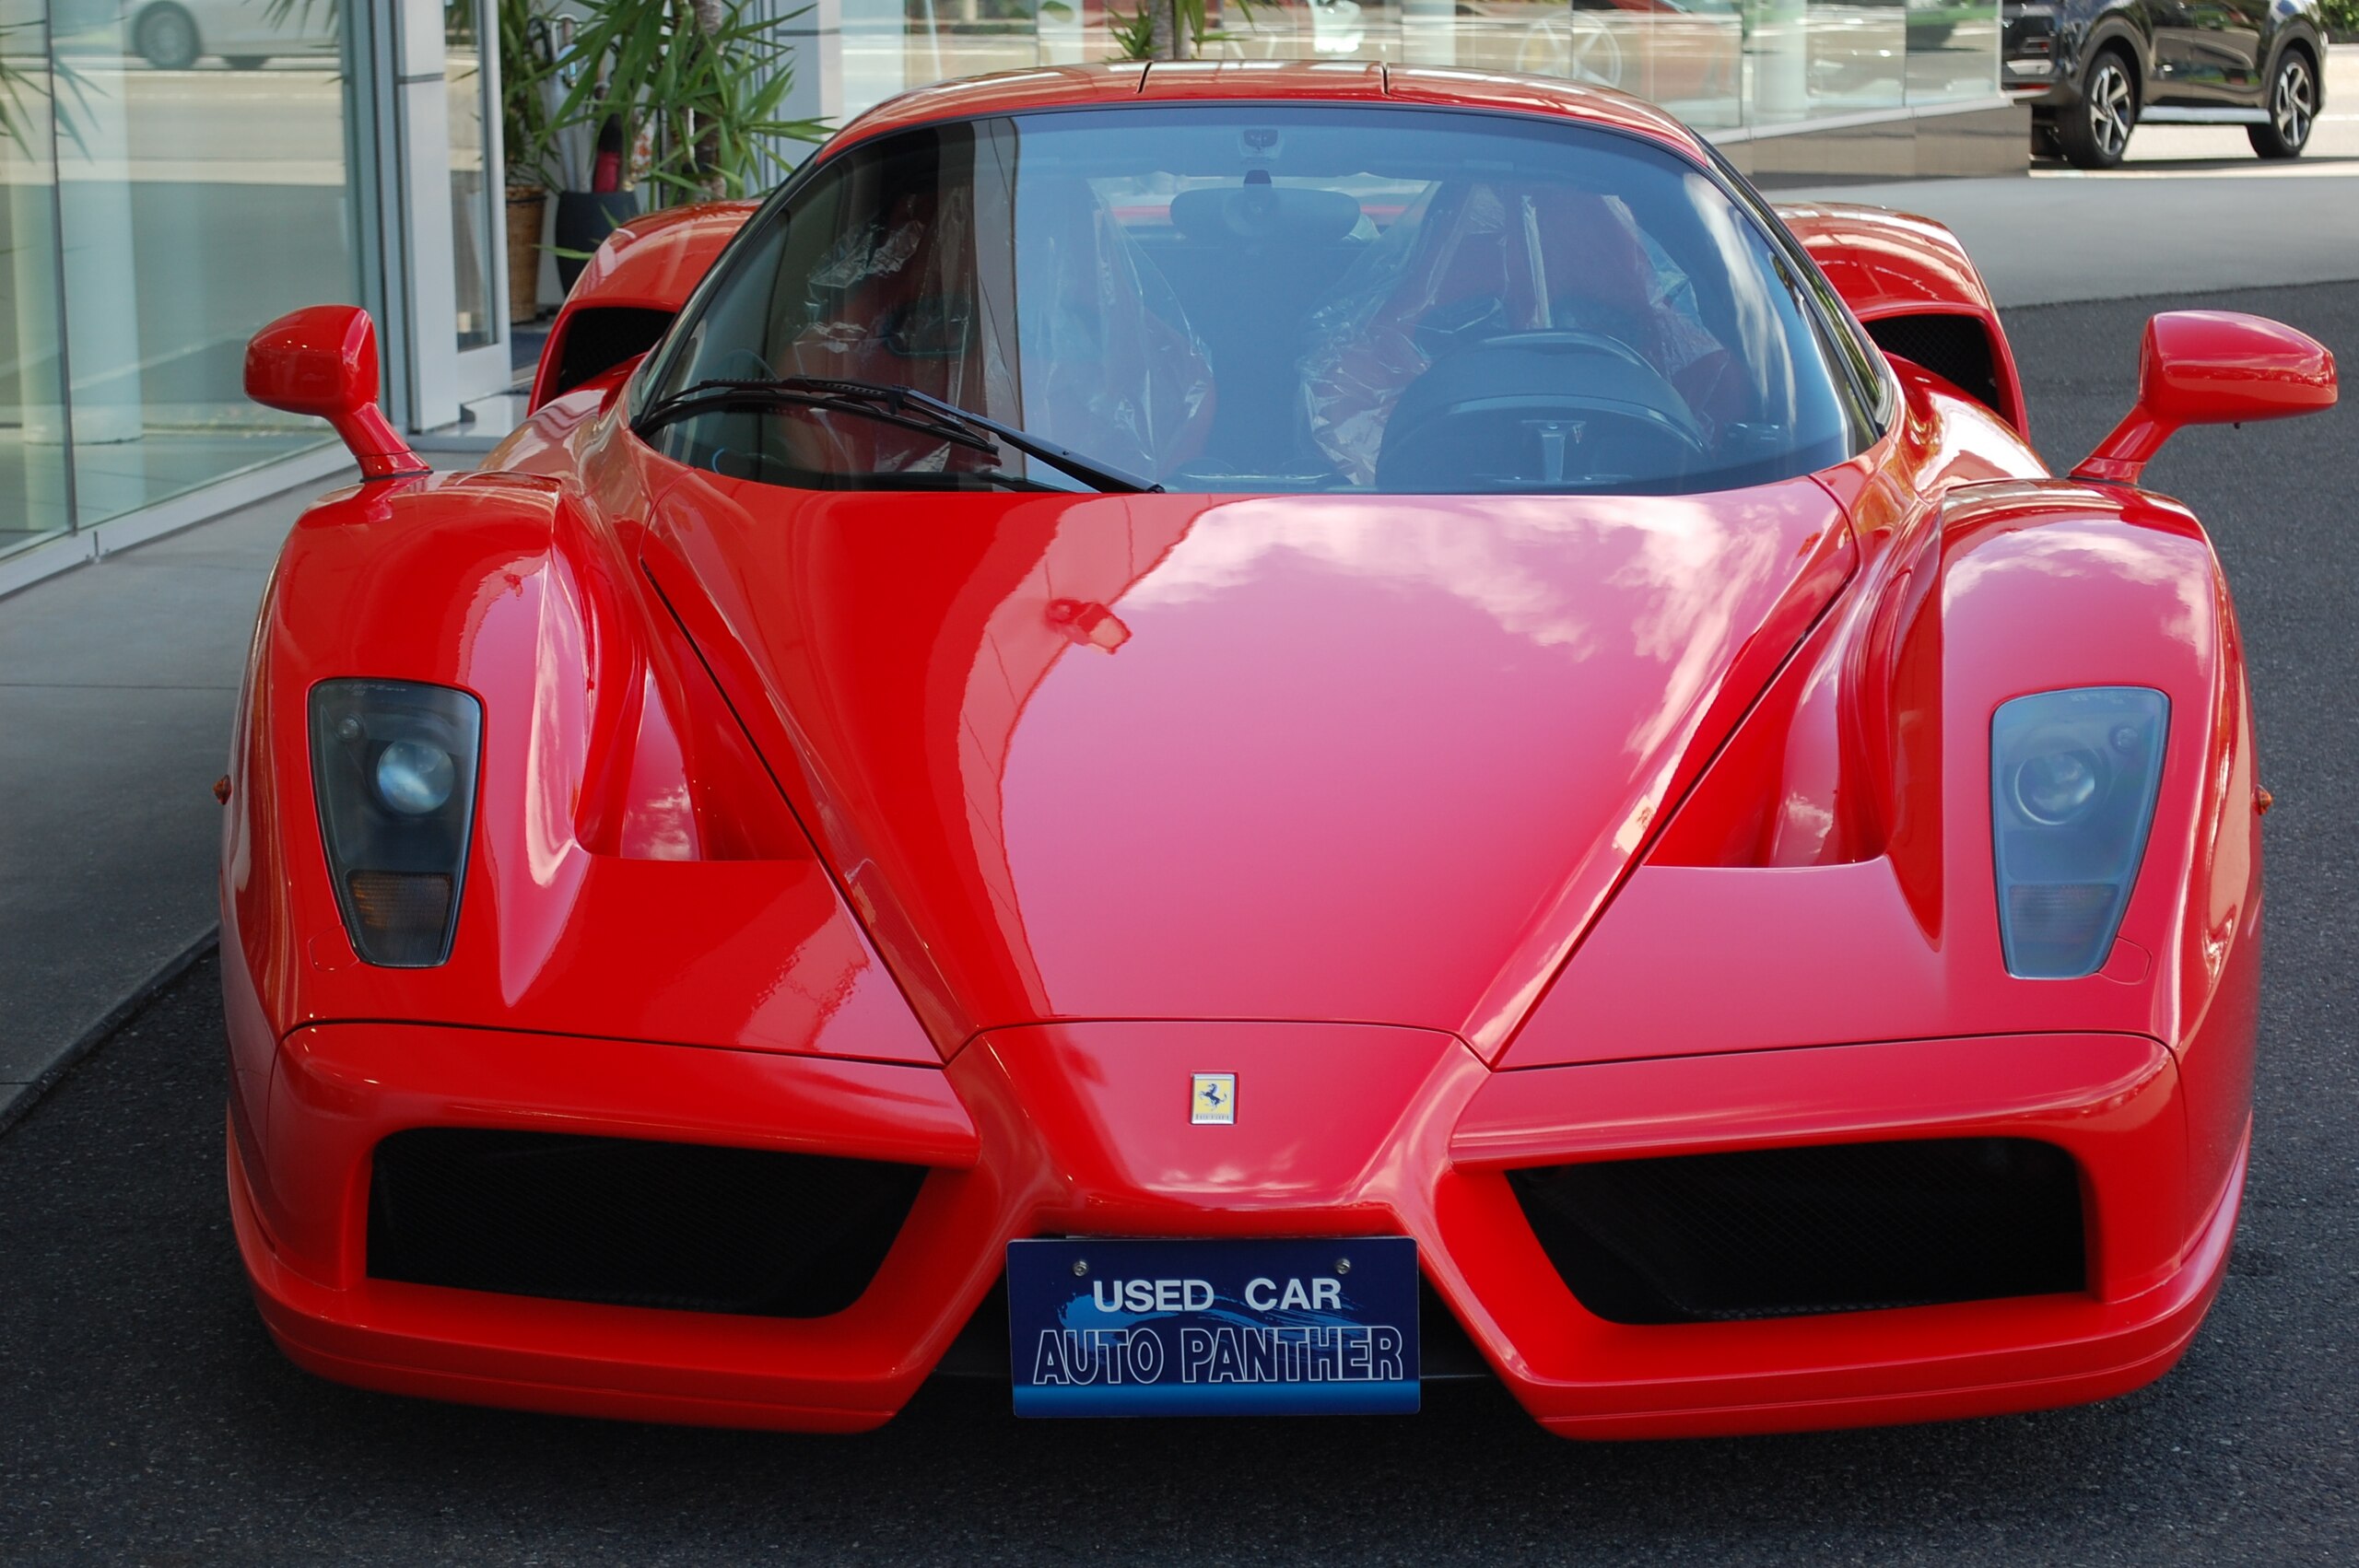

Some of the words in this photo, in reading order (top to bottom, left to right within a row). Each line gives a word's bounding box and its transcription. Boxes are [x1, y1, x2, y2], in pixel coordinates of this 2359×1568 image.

[1093, 1280, 1215, 1312] USED
[1245, 1278, 1342, 1311] CAR
[1033, 1328, 1165, 1385] AUTO
[1180, 1326, 1403, 1383] PANTHER
